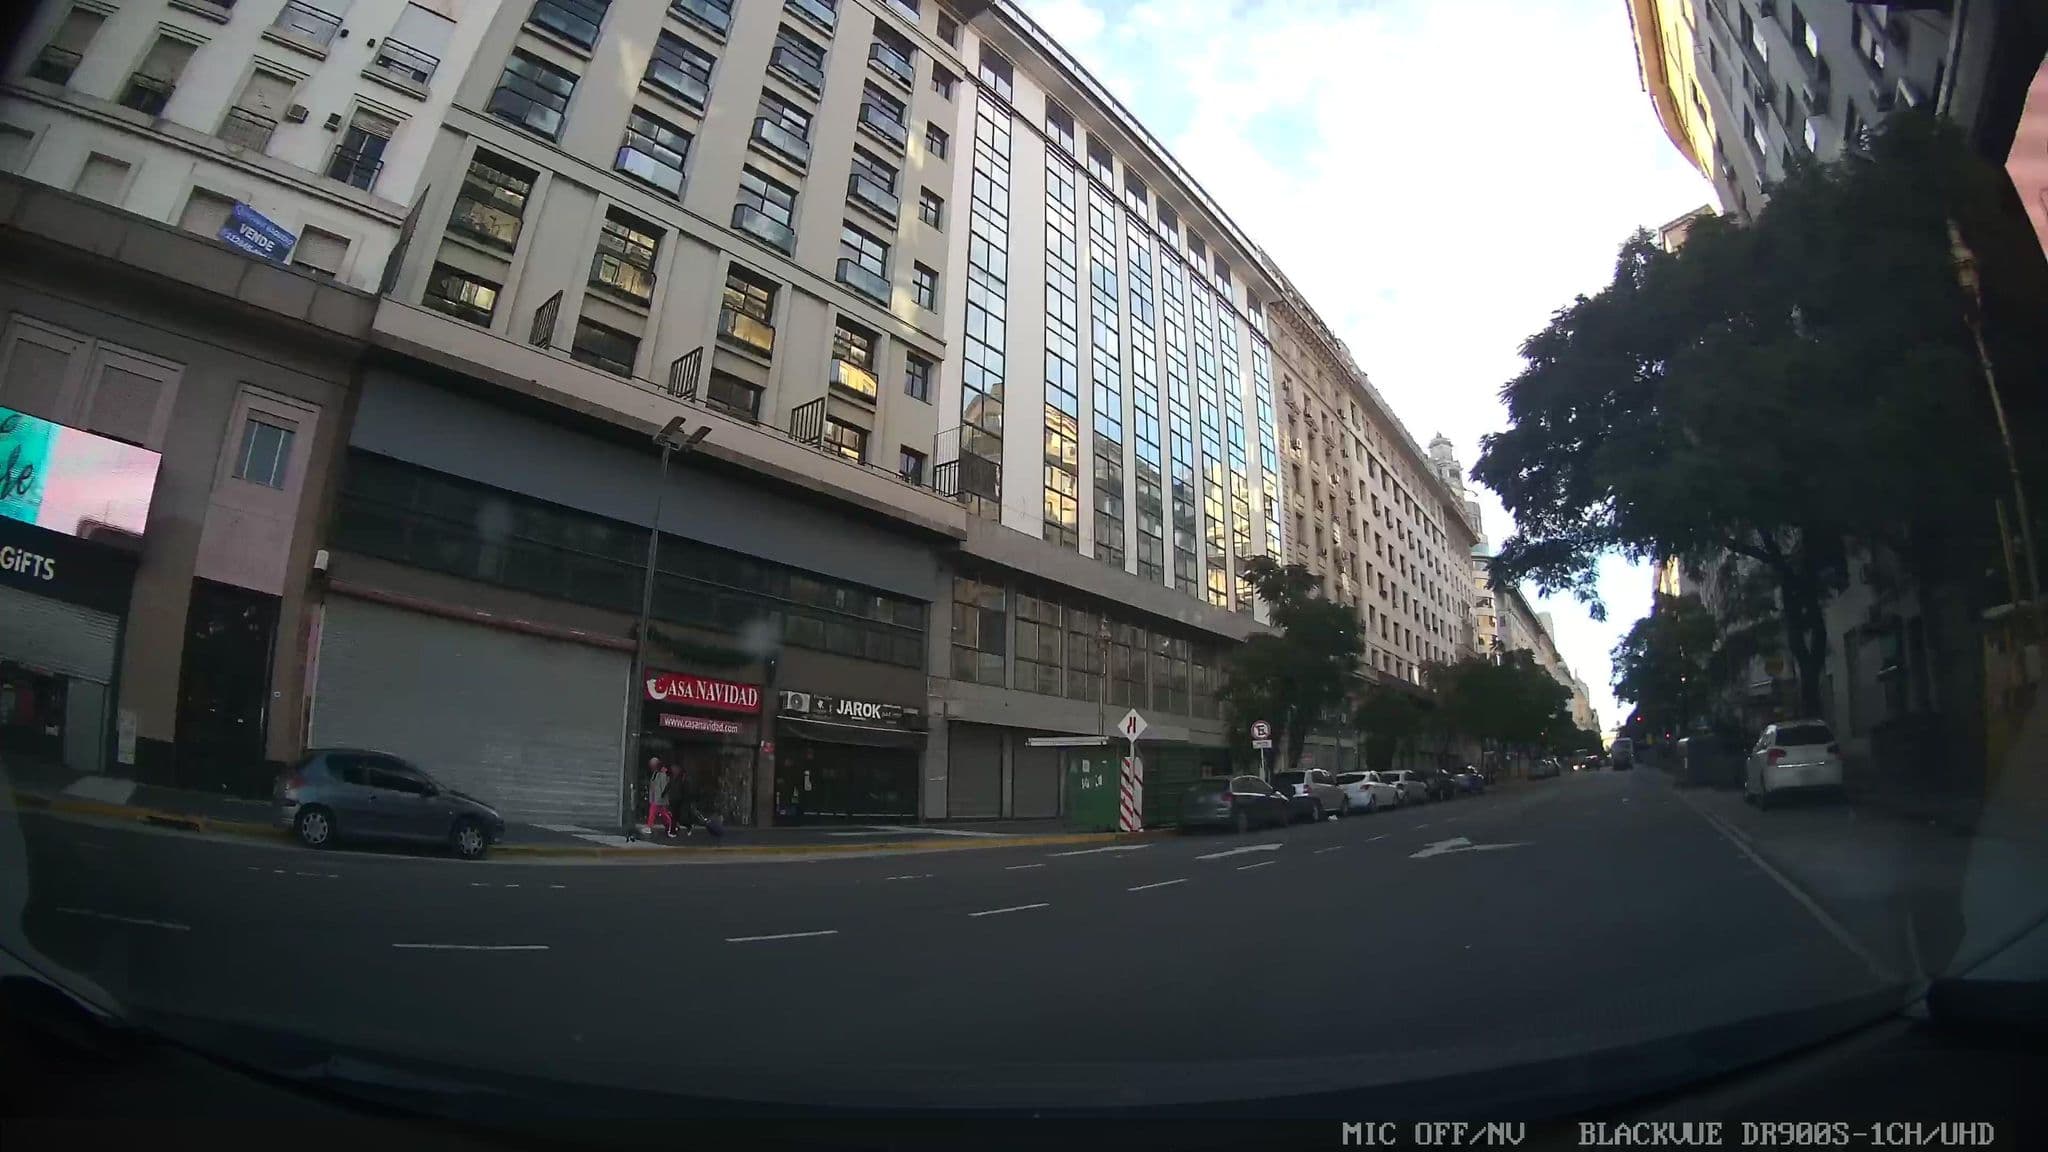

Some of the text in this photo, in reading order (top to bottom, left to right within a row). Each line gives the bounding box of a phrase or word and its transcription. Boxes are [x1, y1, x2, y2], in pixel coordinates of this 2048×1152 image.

[240, 223, 276, 252] VENDE
[646, 678, 758, 707] CASA NAVIDAD
[836, 700, 881, 720] JAROK
